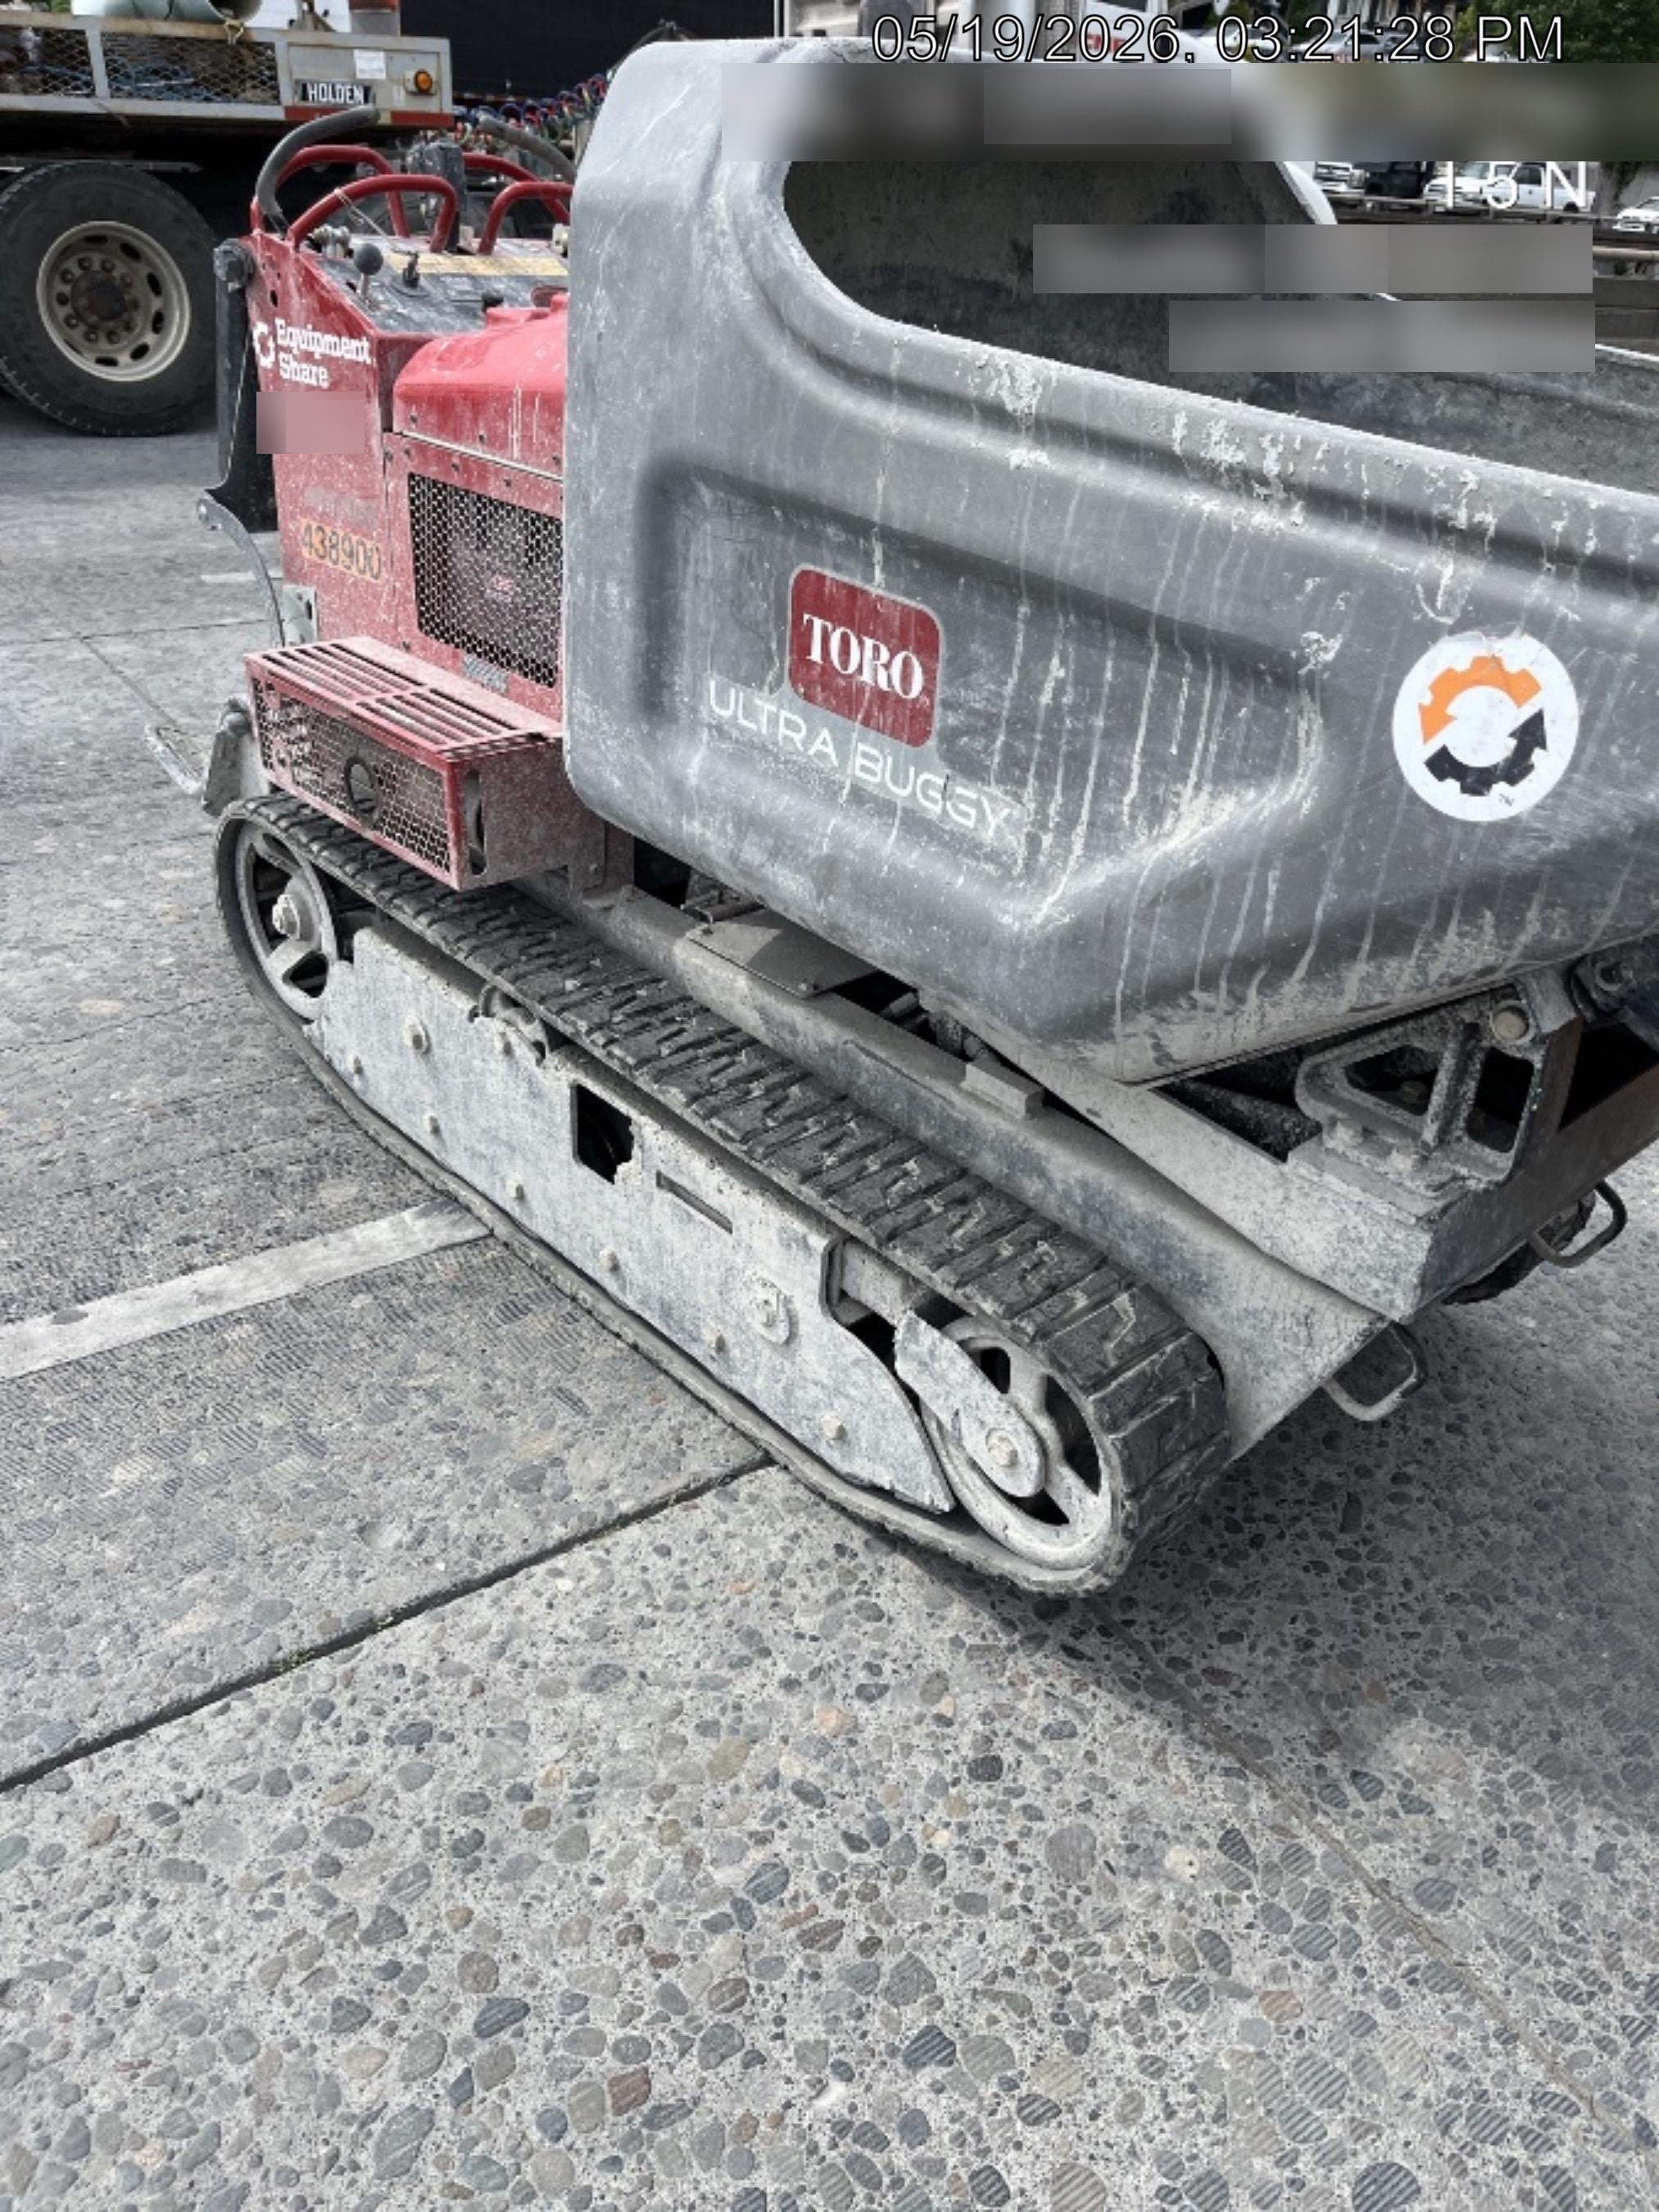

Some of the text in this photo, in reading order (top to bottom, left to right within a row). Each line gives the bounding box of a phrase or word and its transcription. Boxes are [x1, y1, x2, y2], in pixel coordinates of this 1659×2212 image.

[306, 82, 365, 104] HOLDEN
[274, 317, 372, 365] Equipment
[279, 351, 330, 389] Share
[301, 523, 382, 581] 438900
[802, 613, 924, 700] TORO
[709, 678, 1013, 837] ULTRA BUGGY
